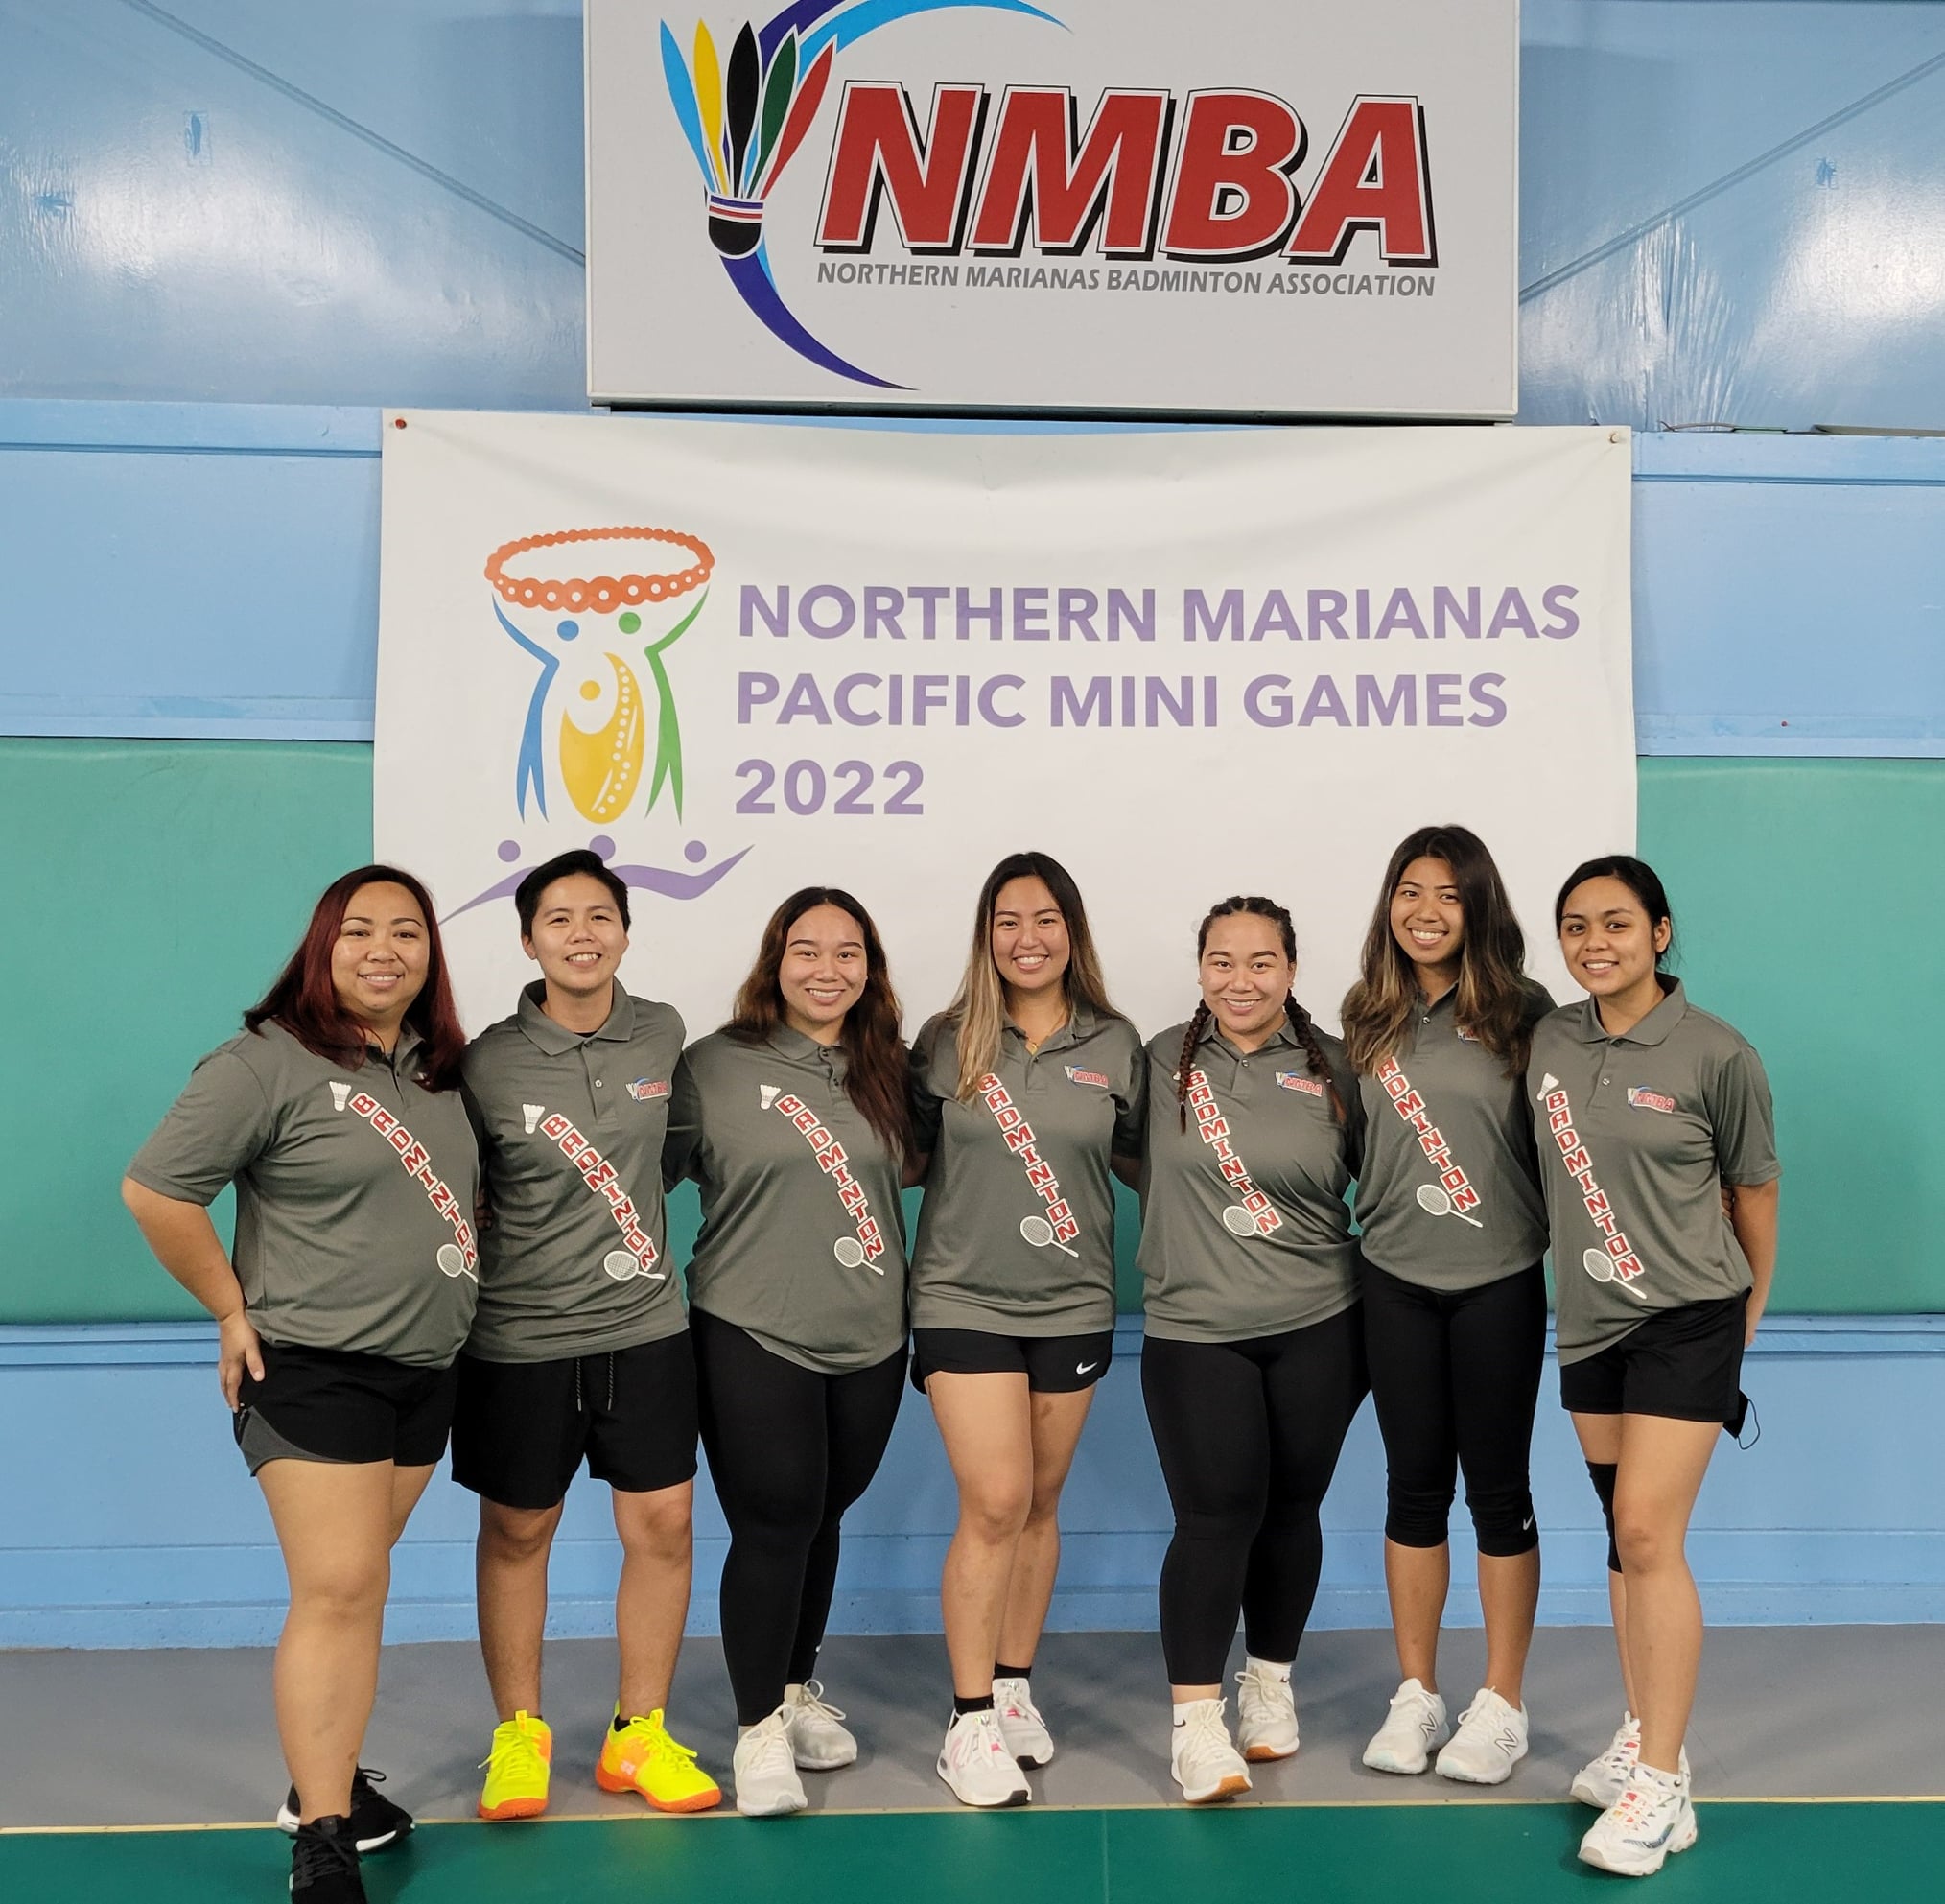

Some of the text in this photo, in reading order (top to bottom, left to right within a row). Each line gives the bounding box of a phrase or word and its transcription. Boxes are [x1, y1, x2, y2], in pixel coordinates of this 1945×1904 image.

[815, 80, 1439, 267] NMBA
[817, 261, 1435, 297] NORTHERN MARIANAS BADMINTON ASSOCIATION
[738, 584, 1581, 642] NORTHERN MARIANAS
[736, 672, 1509, 728] PACIFIC MINI GAMES
[735, 758, 926, 816] 2022
[977, 1072, 1080, 1244] BADMINTON
[1186, 1070, 1283, 1236] BADMINTON
[1284, 1076, 1323, 1097] NMBA
[1376, 1055, 1482, 1213] ADMINTON
[1633, 1092, 1675, 1113] NMBA
[348, 1092, 478, 1271] BADMINTON
[539, 1112, 659, 1272] BADMINTON
[774, 1093, 885, 1262] BADMINTON
[1545, 1090, 1645, 1282] BADMINTON
